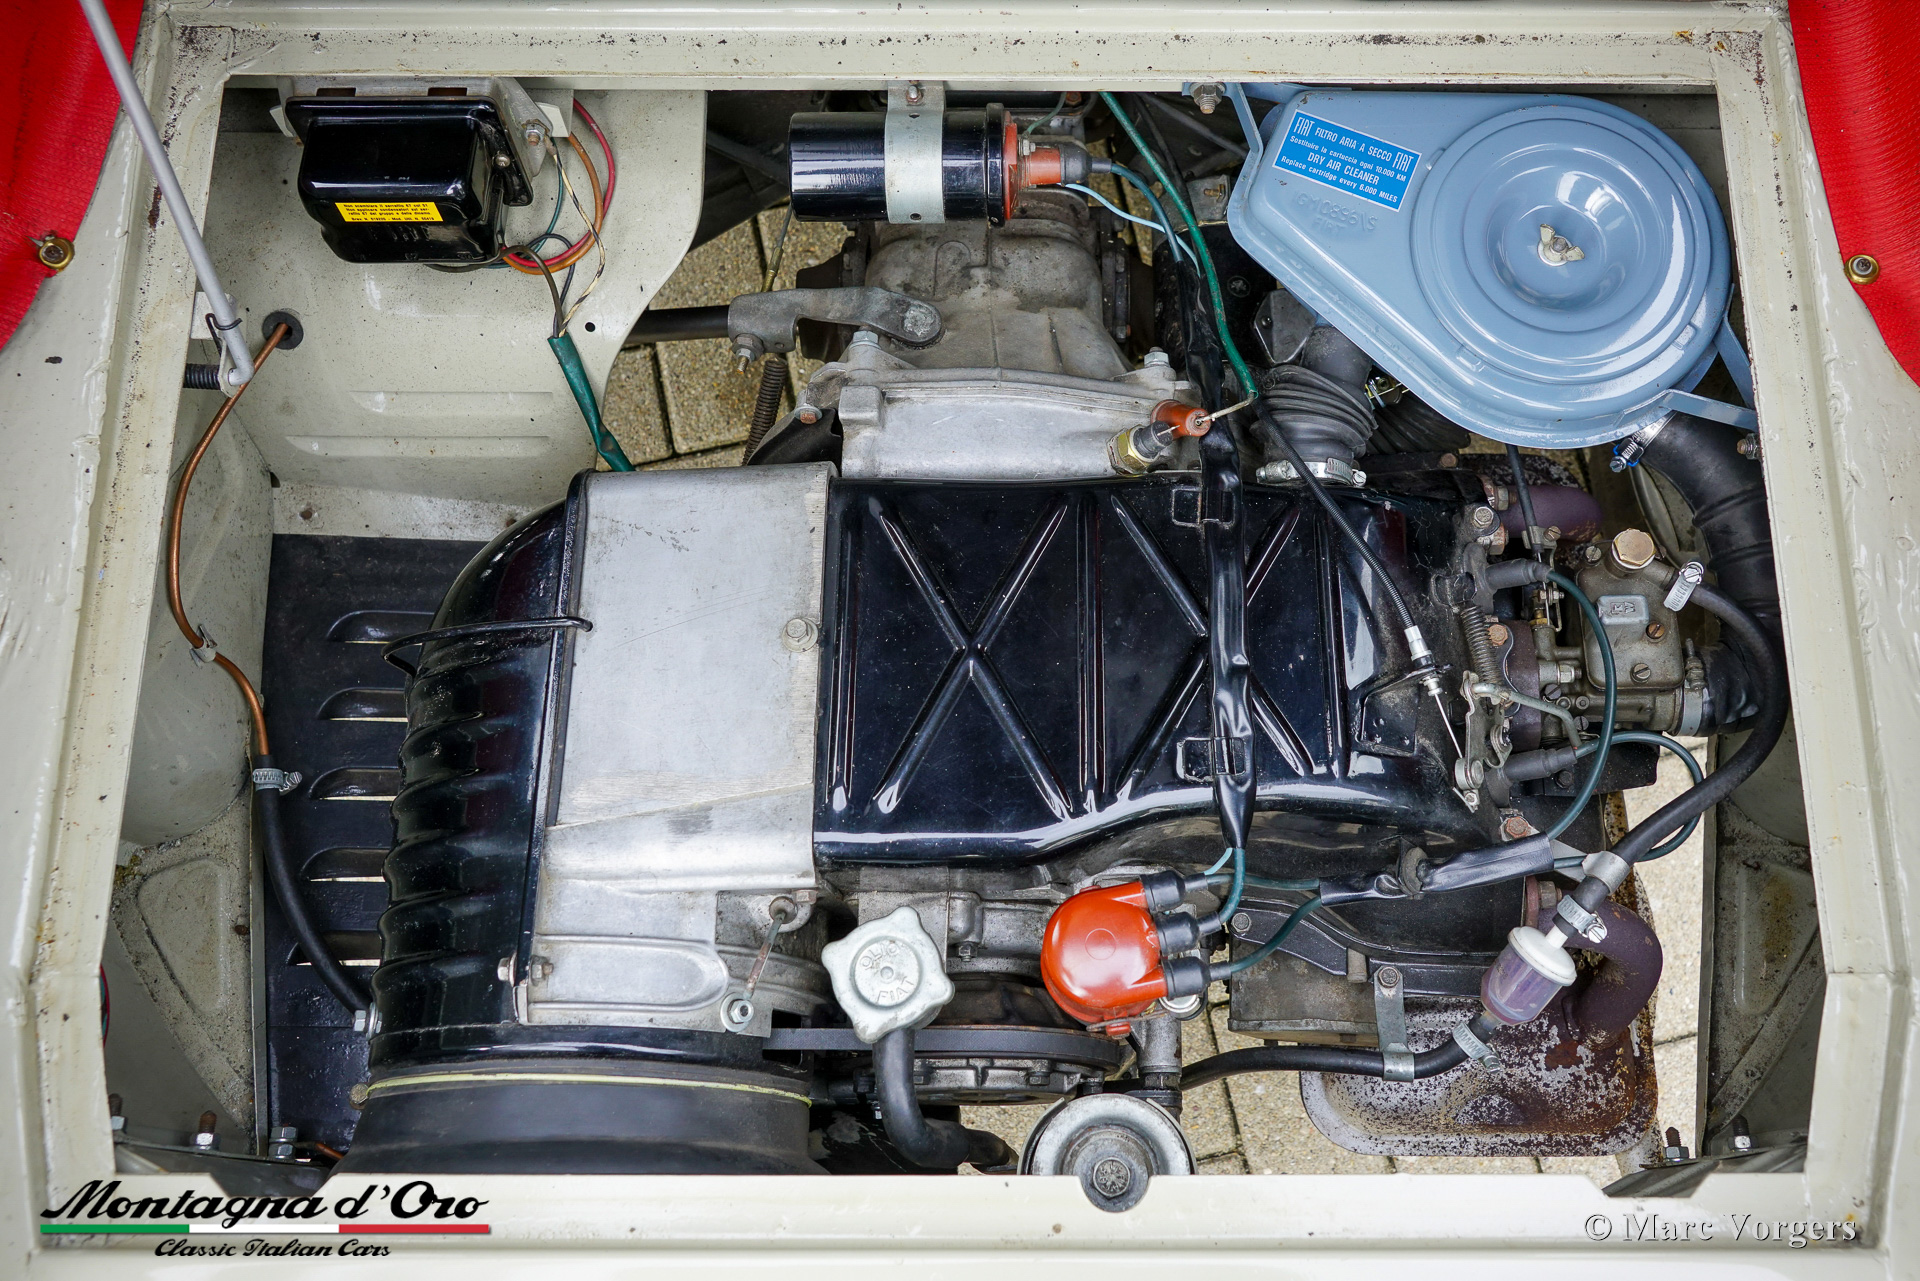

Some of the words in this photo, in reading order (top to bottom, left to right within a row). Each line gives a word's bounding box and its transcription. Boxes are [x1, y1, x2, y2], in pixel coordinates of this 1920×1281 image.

[1290, 135, 1319, 151] Sostituire
[1321, 145, 1328, 153] la
[1329, 150, 1358, 165] cartuccia
[1359, 160, 1374, 170] ogni
[1375, 165, 1395, 178] 10.000
[1396, 173, 1407, 183] KM
[1293, 117, 1315, 137] FIAT
[1315, 127, 1338, 142] FILTRO
[1339, 136, 1357, 149] ARIA
[1359, 143, 1365, 152] A
[1367, 146, 1393, 162] SECCO
[1392, 151, 1414, 173] FIAT
[1307, 152, 1326, 166] DRY
[1326, 159, 1341, 171] AIR
[1344, 165, 1380, 185] CLEANER
[1281, 155, 1307, 170] Replace
[1308, 165, 1337, 182] cartridge
[1339, 178, 1358, 189] every
[1359, 184, 1378, 196] 6.000
[1378, 190, 1398, 203] MILES
[876, 975, 914, 1004] FIAT
